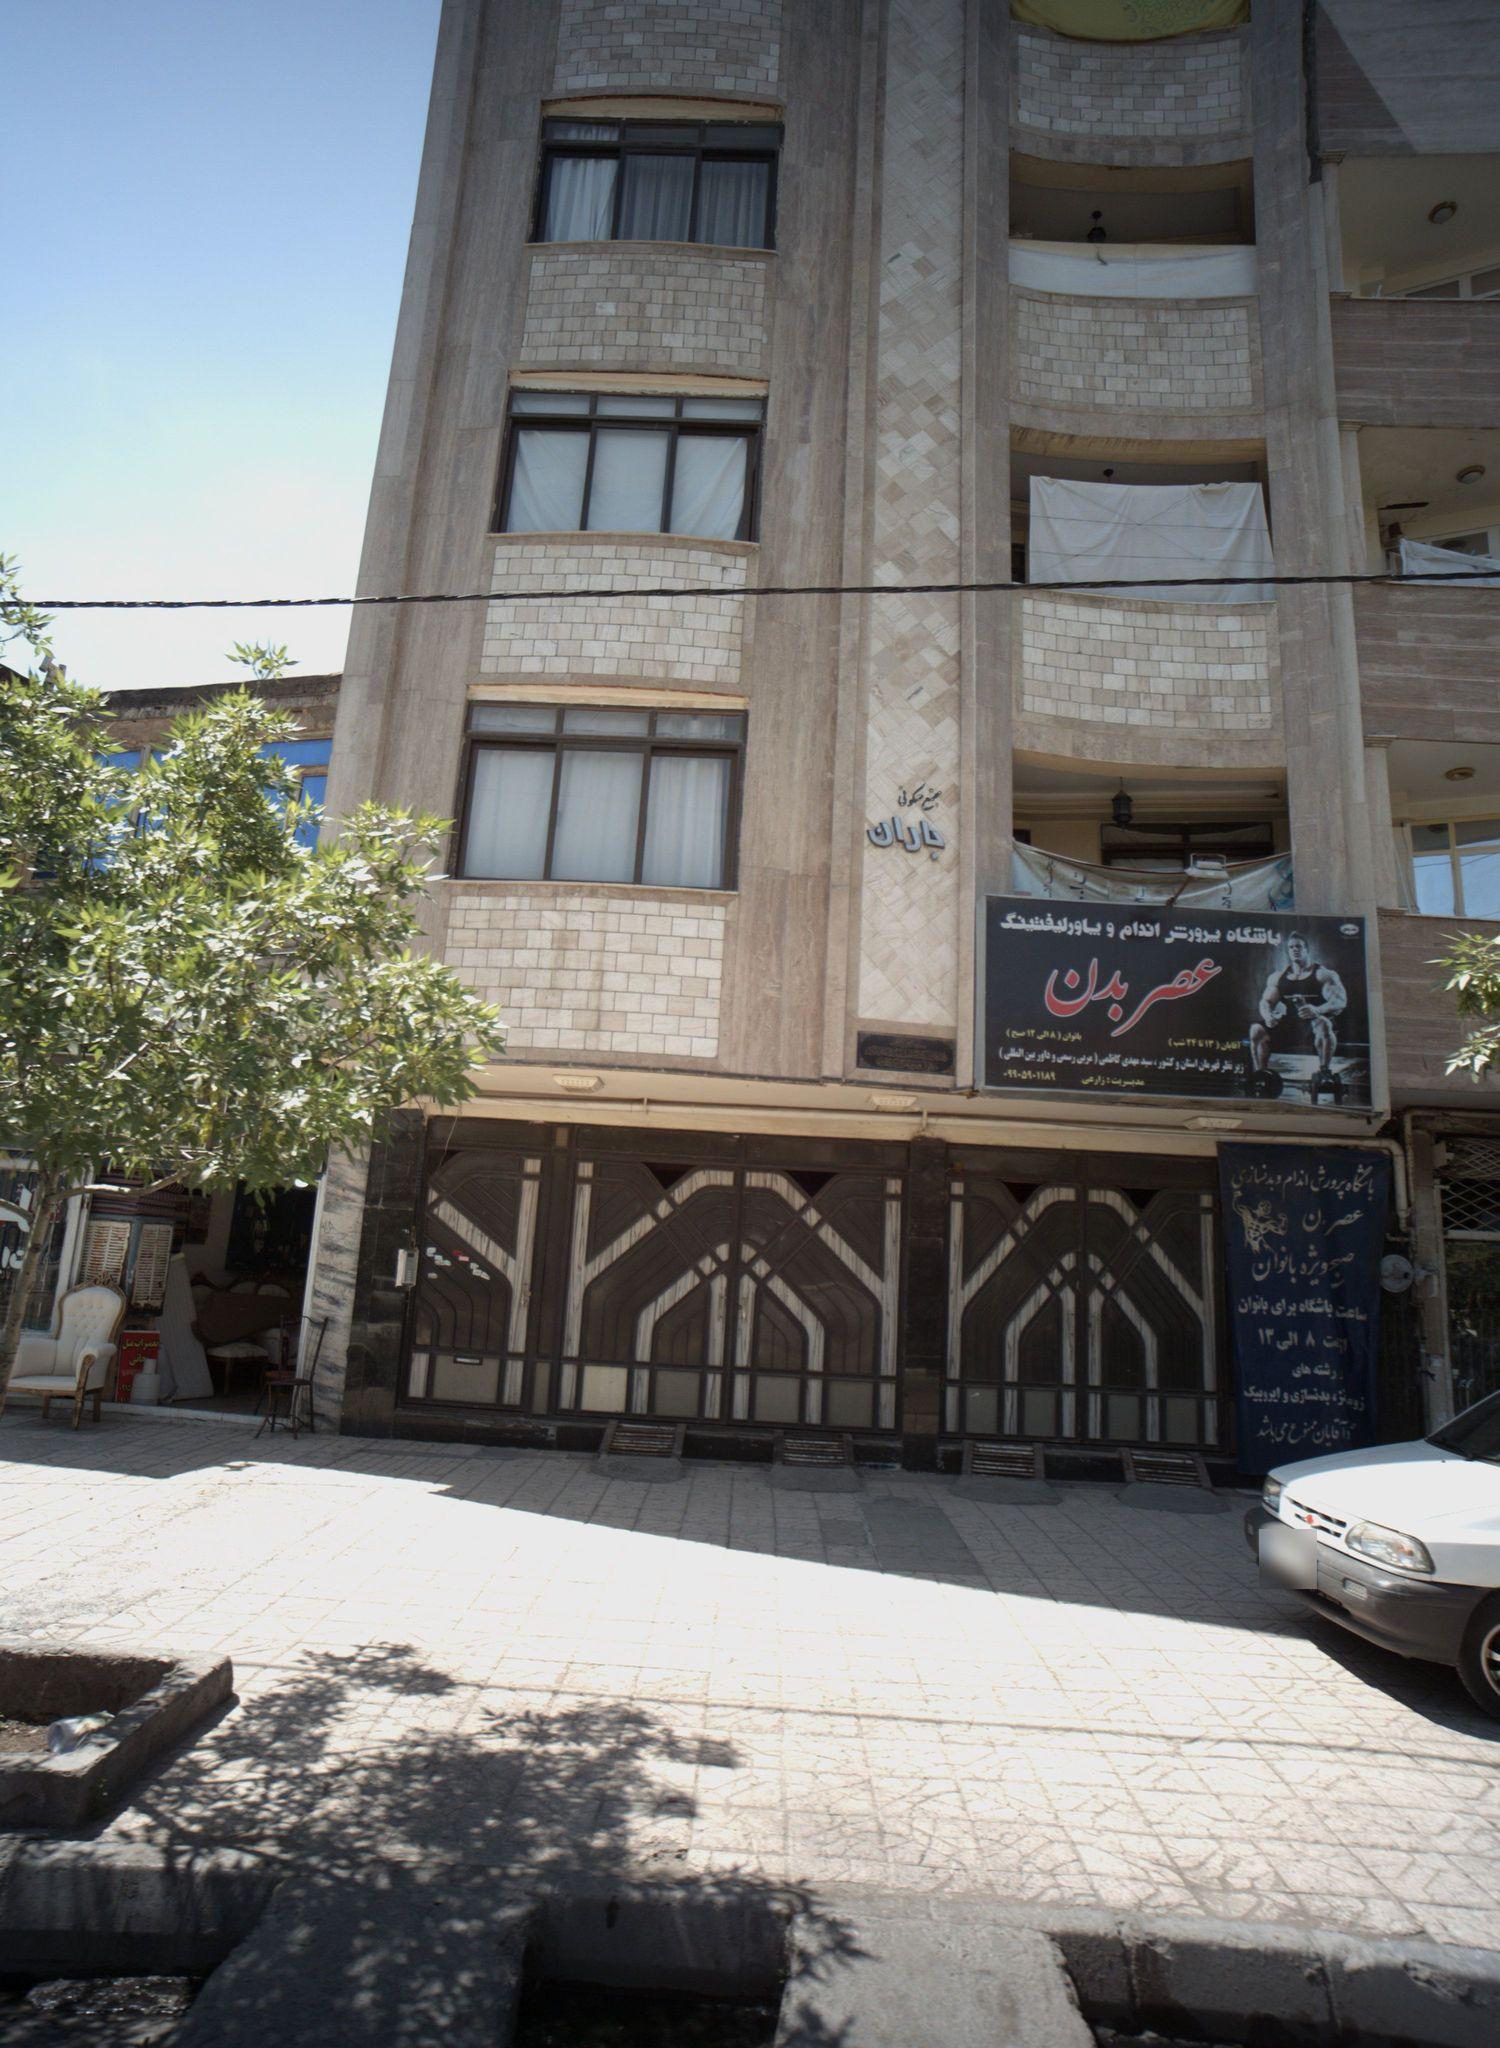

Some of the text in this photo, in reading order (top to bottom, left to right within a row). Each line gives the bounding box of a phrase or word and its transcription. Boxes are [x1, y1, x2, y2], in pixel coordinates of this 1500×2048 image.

[866, 815, 945, 861] باران
[1106, 921, 1115, 938] و
[1119, 920, 1160, 941] اندام
[1164, 926, 1221, 944] پرورش
[1226, 926, 1282, 946] باشگاه
[1045, 958, 1222, 1037] عصر بدن
[1282, 1169, 1309, 1200] اندام
[1310, 1164, 1347, 1200] پرورش
[1345, 1164, 1374, 1201] باشگاه
[1324, 1209, 1365, 1236] عصر
[1252, 1245, 1297, 1284] بانوان
[1238, 1295, 1268, 1315] بانوان
[1271, 1297, 1297, 1316] برای
[1299, 1297, 1333, 1317] باشگاه
[1276, 1331, 1298, 1351] الی
[1305, 1330, 1316, 1347] ۸
[1292, 1363, 1311, 1378] های
